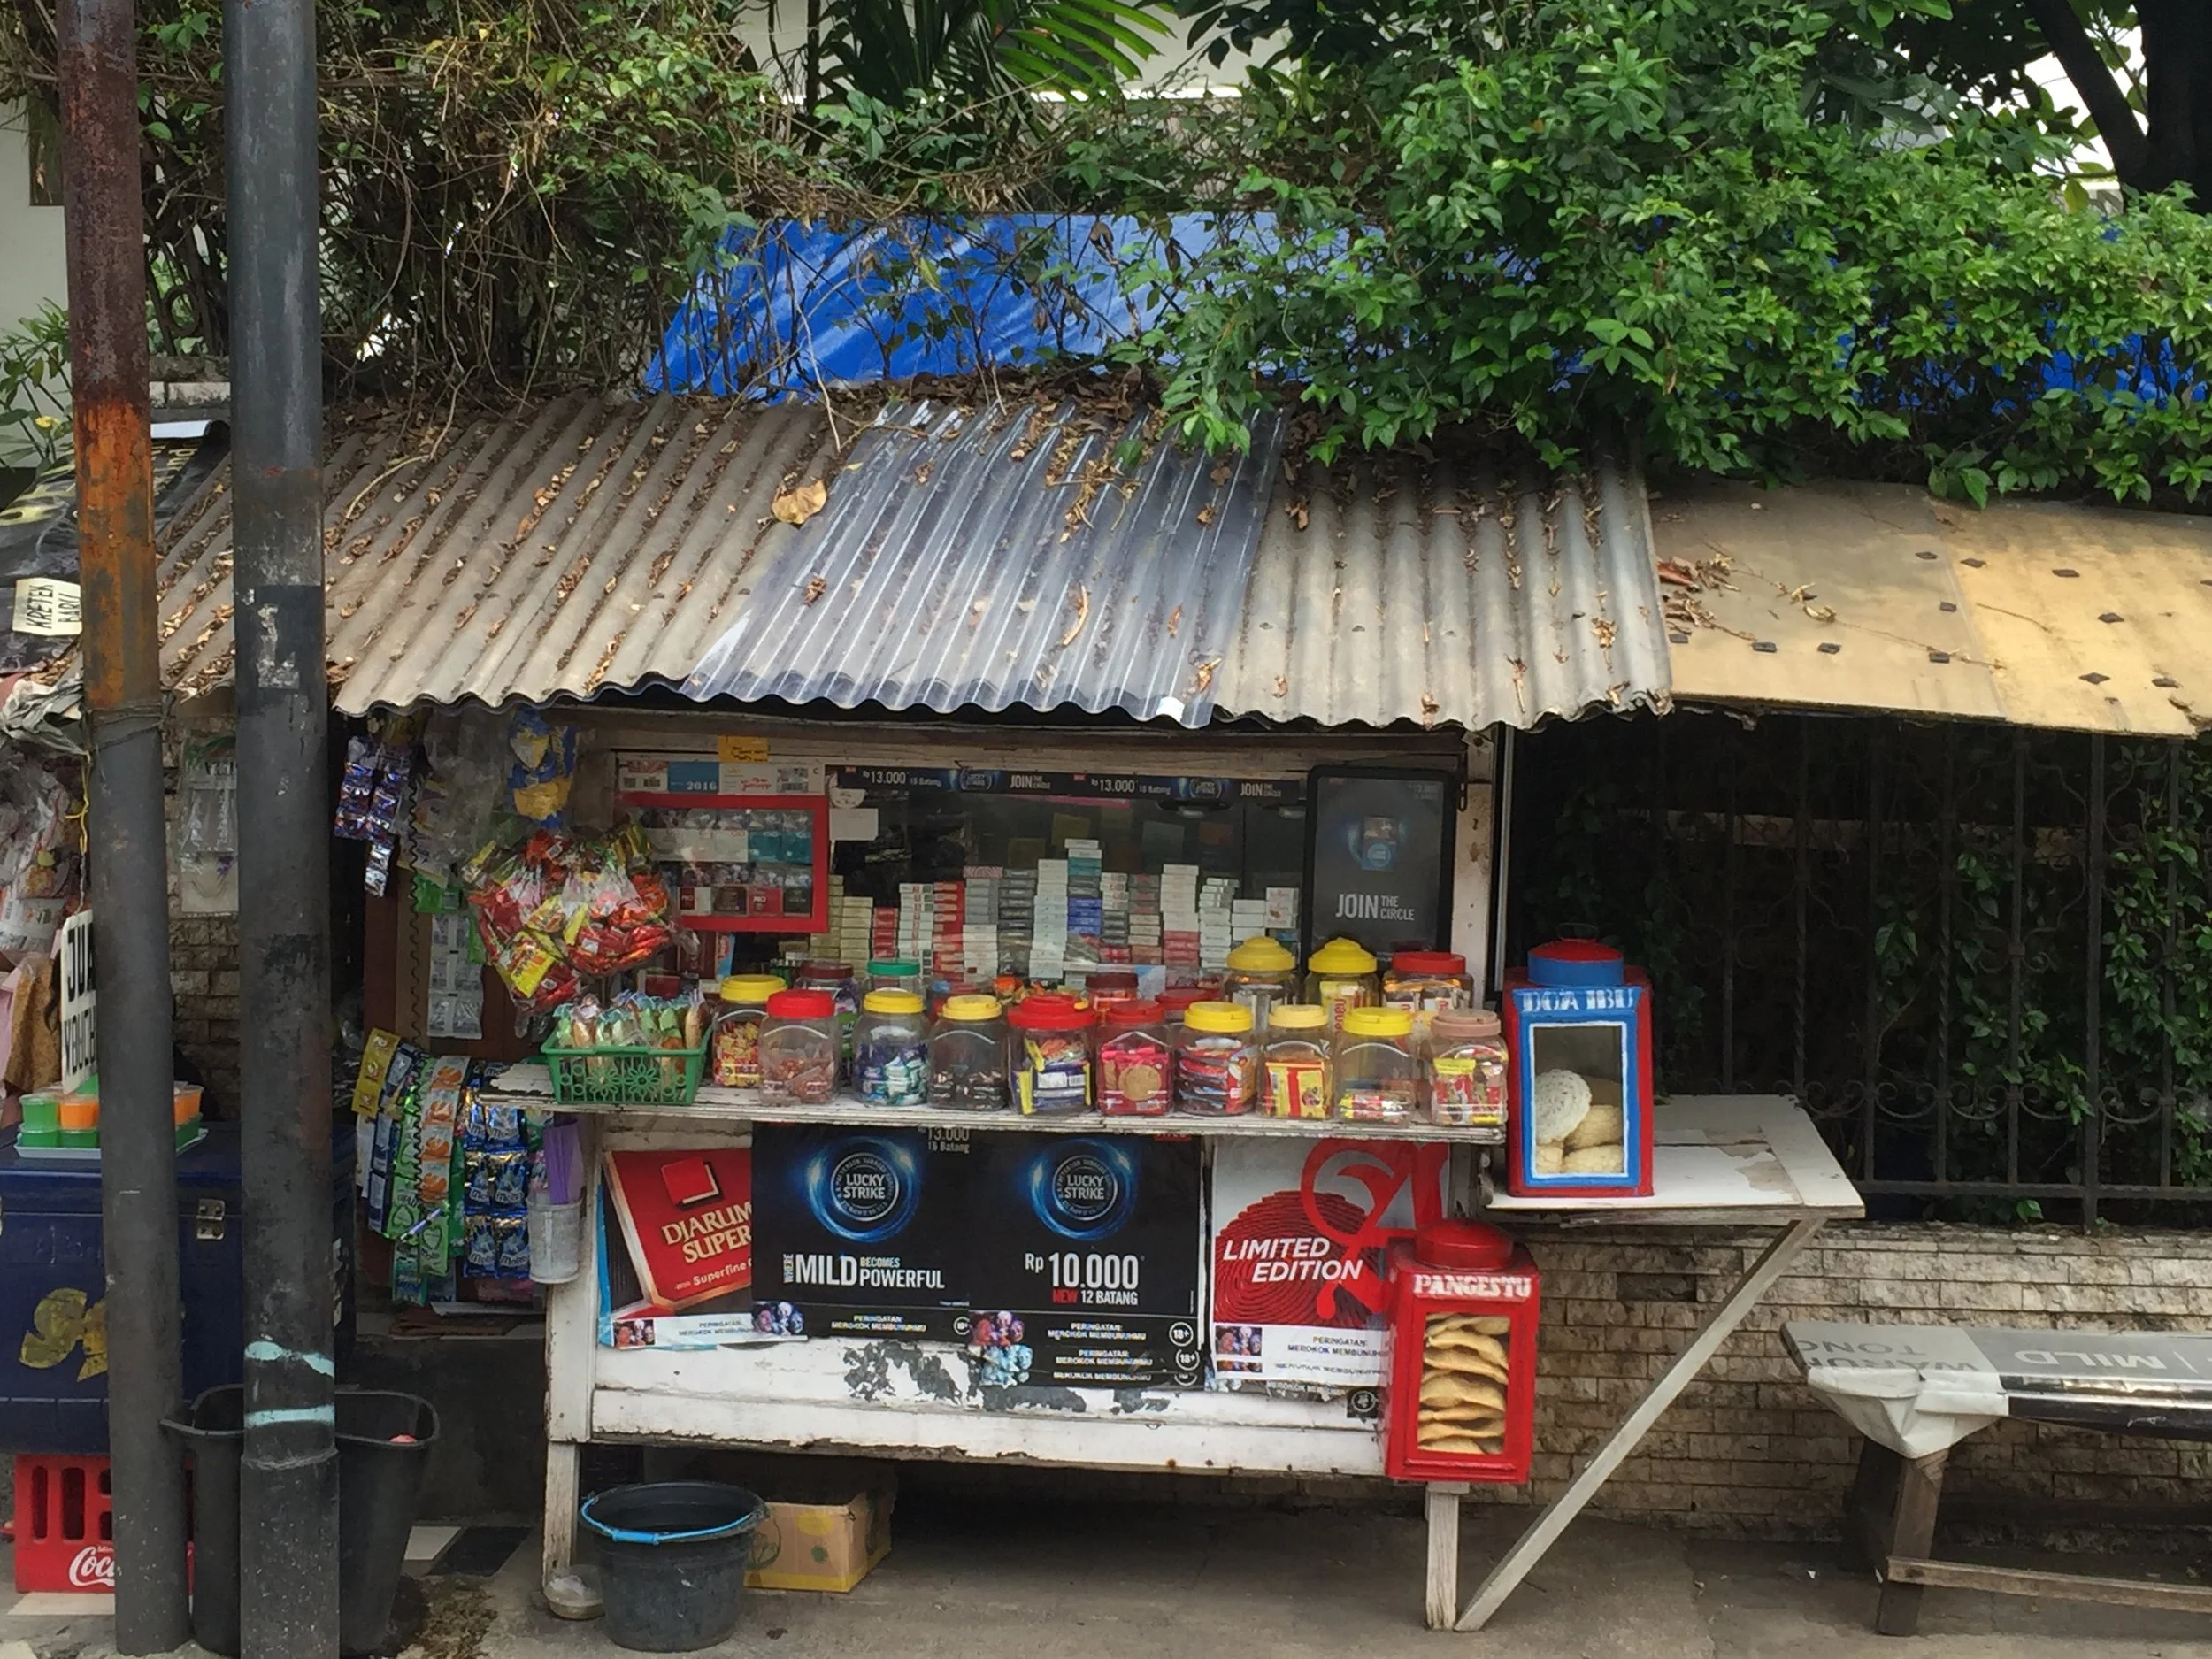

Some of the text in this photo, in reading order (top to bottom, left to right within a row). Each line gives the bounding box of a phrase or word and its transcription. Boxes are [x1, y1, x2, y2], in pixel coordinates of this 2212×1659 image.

[26, 585, 53, 629] KRETEK
[871, 771, 906, 785] 13.000
[1010, 775, 1033, 788] JOIN
[687, 780, 717, 791] 2016
[1100, 780, 1135, 793] 13.000
[1240, 783, 1263, 797] JOIN
[1336, 894, 1379, 918] JOIN
[1381, 895, 1398, 907] THE
[1381, 909, 1415, 921] CIRCLE
[1522, 988, 1634, 1012] DOA IBU
[846, 1173, 885, 1187] LUCKY
[1067, 1175, 1103, 1187] LUCKY
[843, 1187, 886, 1200] STRIKE
[1064, 1187, 1105, 1200] STRIKE
[662, 1201, 752, 1245] DJARUM
[682, 1225, 752, 1263] SUPER
[1223, 1238, 1330, 1260] LIMITED
[860, 1256, 900, 1268] BECOMES
[693, 1262, 747, 1286] Superfine
[795, 1254, 857, 1286] MILD
[1025, 1252, 1140, 1290] Rp 10.000
[1251, 1259, 1363, 1283] EDITION
[860, 1269, 946, 1289] POWERFUL
[1413, 1274, 1532, 1298] PANGESTU
[1053, 1289, 1138, 1306] NEW 12 BATANG
[1172, 1329, 1190, 1340] 18+
[1287, 1344, 1330, 1354] MEROKOK
[1179, 1353, 1195, 1363] 18+
[2015, 1350, 2168, 1369] MILD
